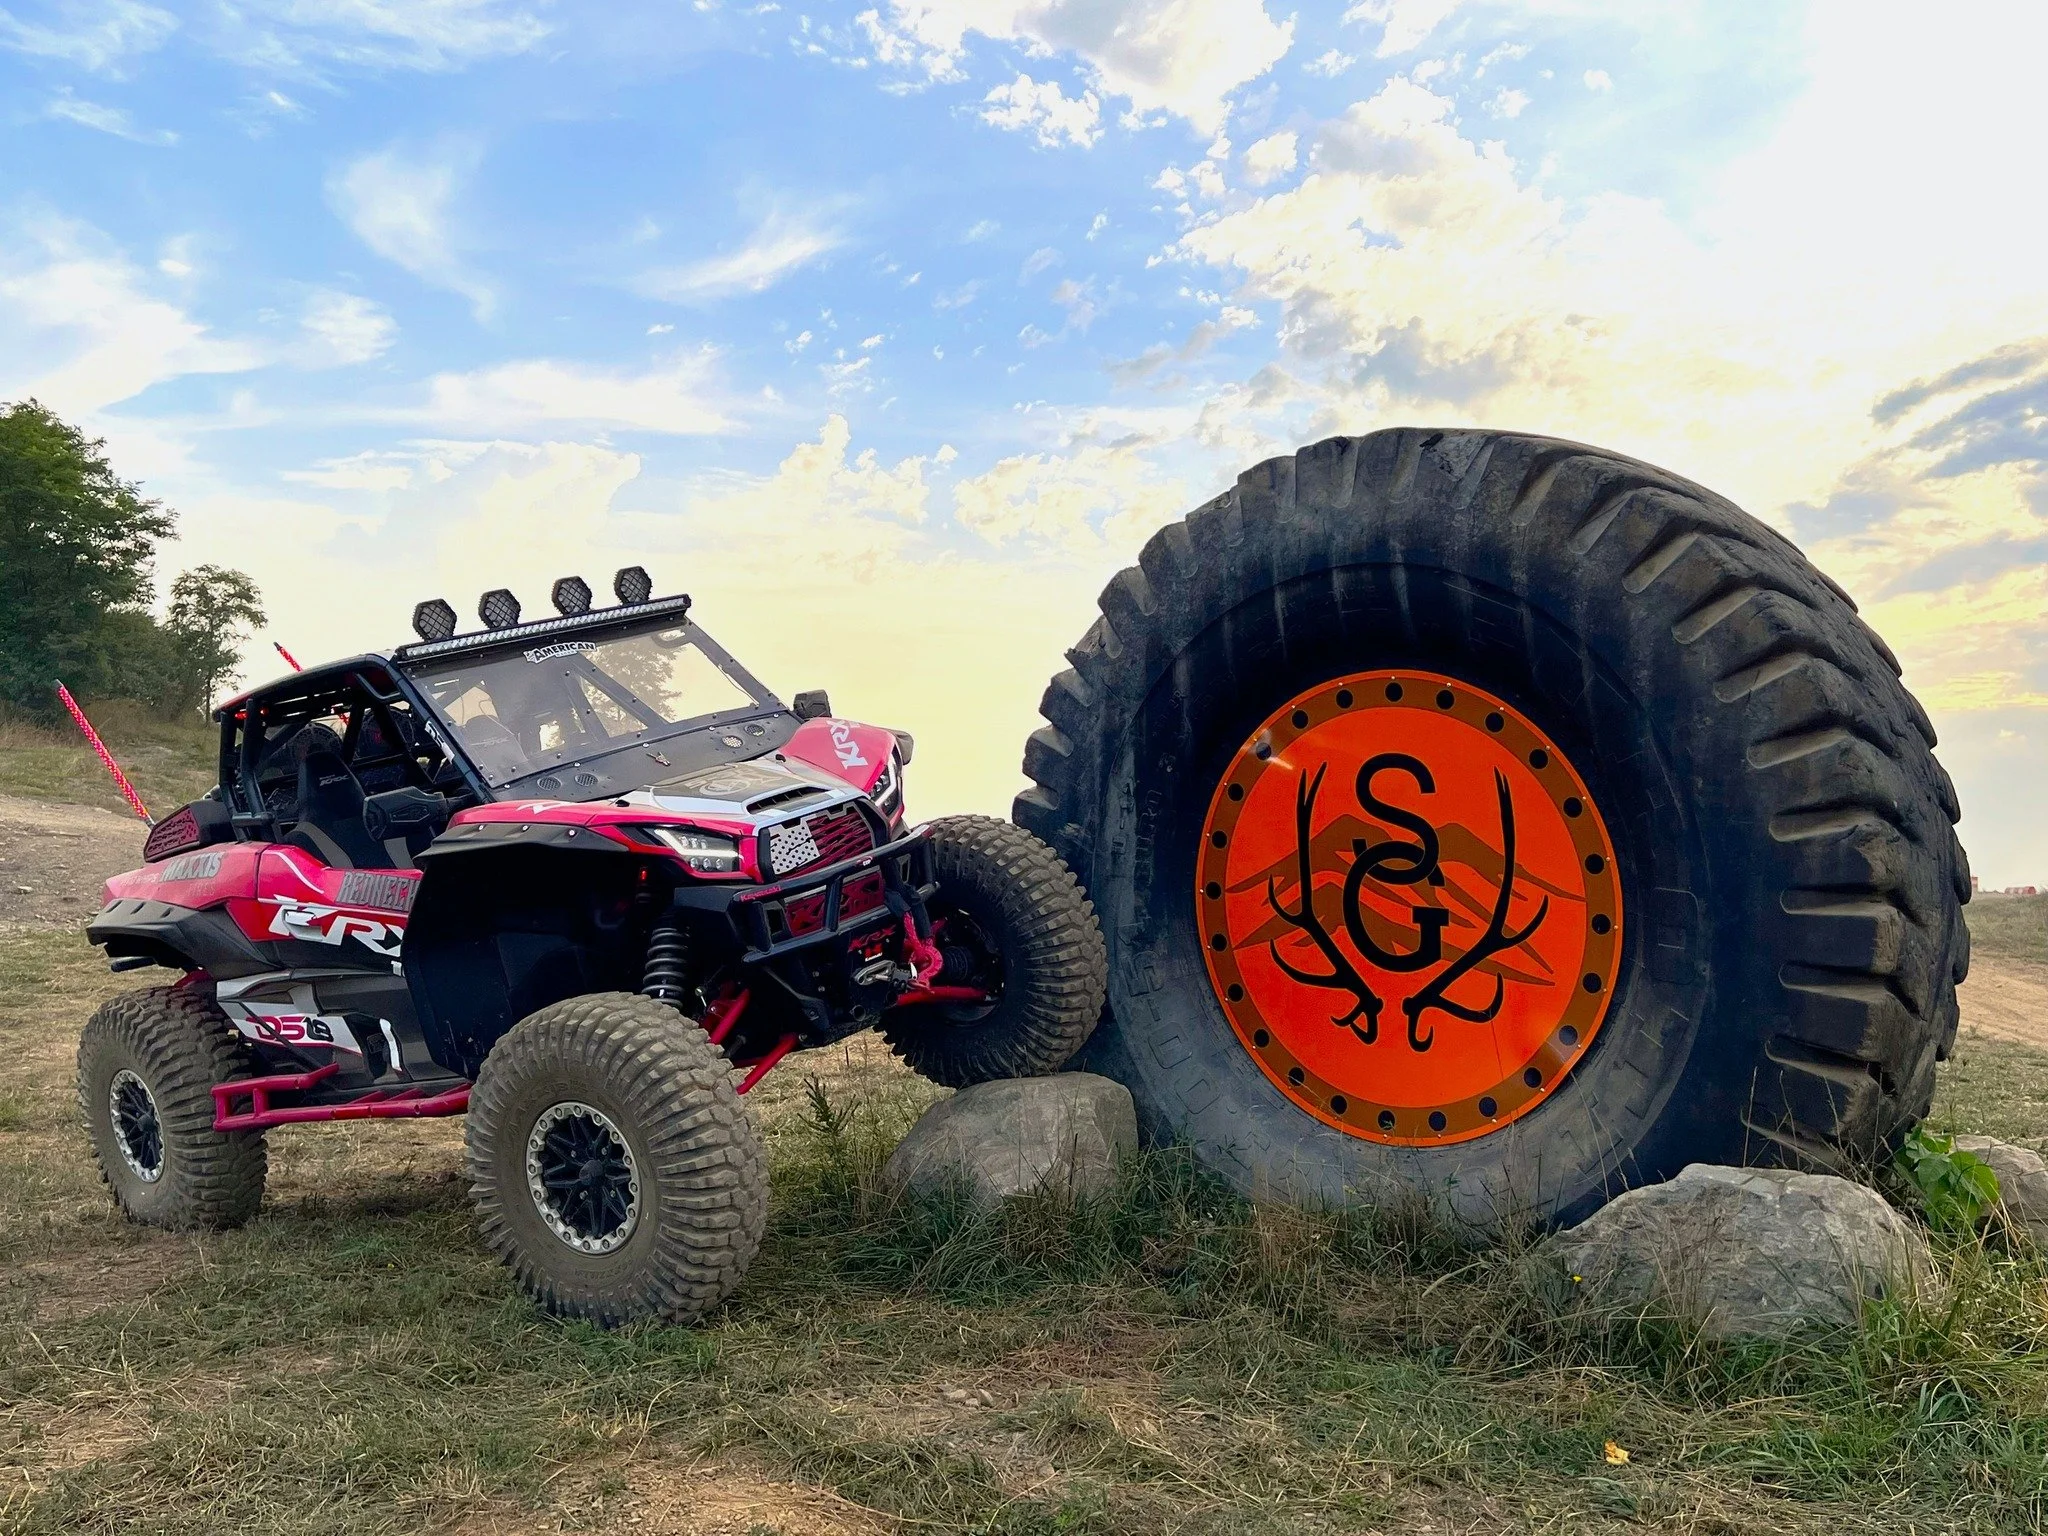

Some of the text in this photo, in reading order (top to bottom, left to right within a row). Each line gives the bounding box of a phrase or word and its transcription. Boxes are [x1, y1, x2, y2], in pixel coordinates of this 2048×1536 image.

[532, 642, 596, 662] AMERICAN
[825, 720, 869, 770] KRX
[160, 851, 225, 882] MAXXIS
[245, 1015, 334, 1042] DS18
